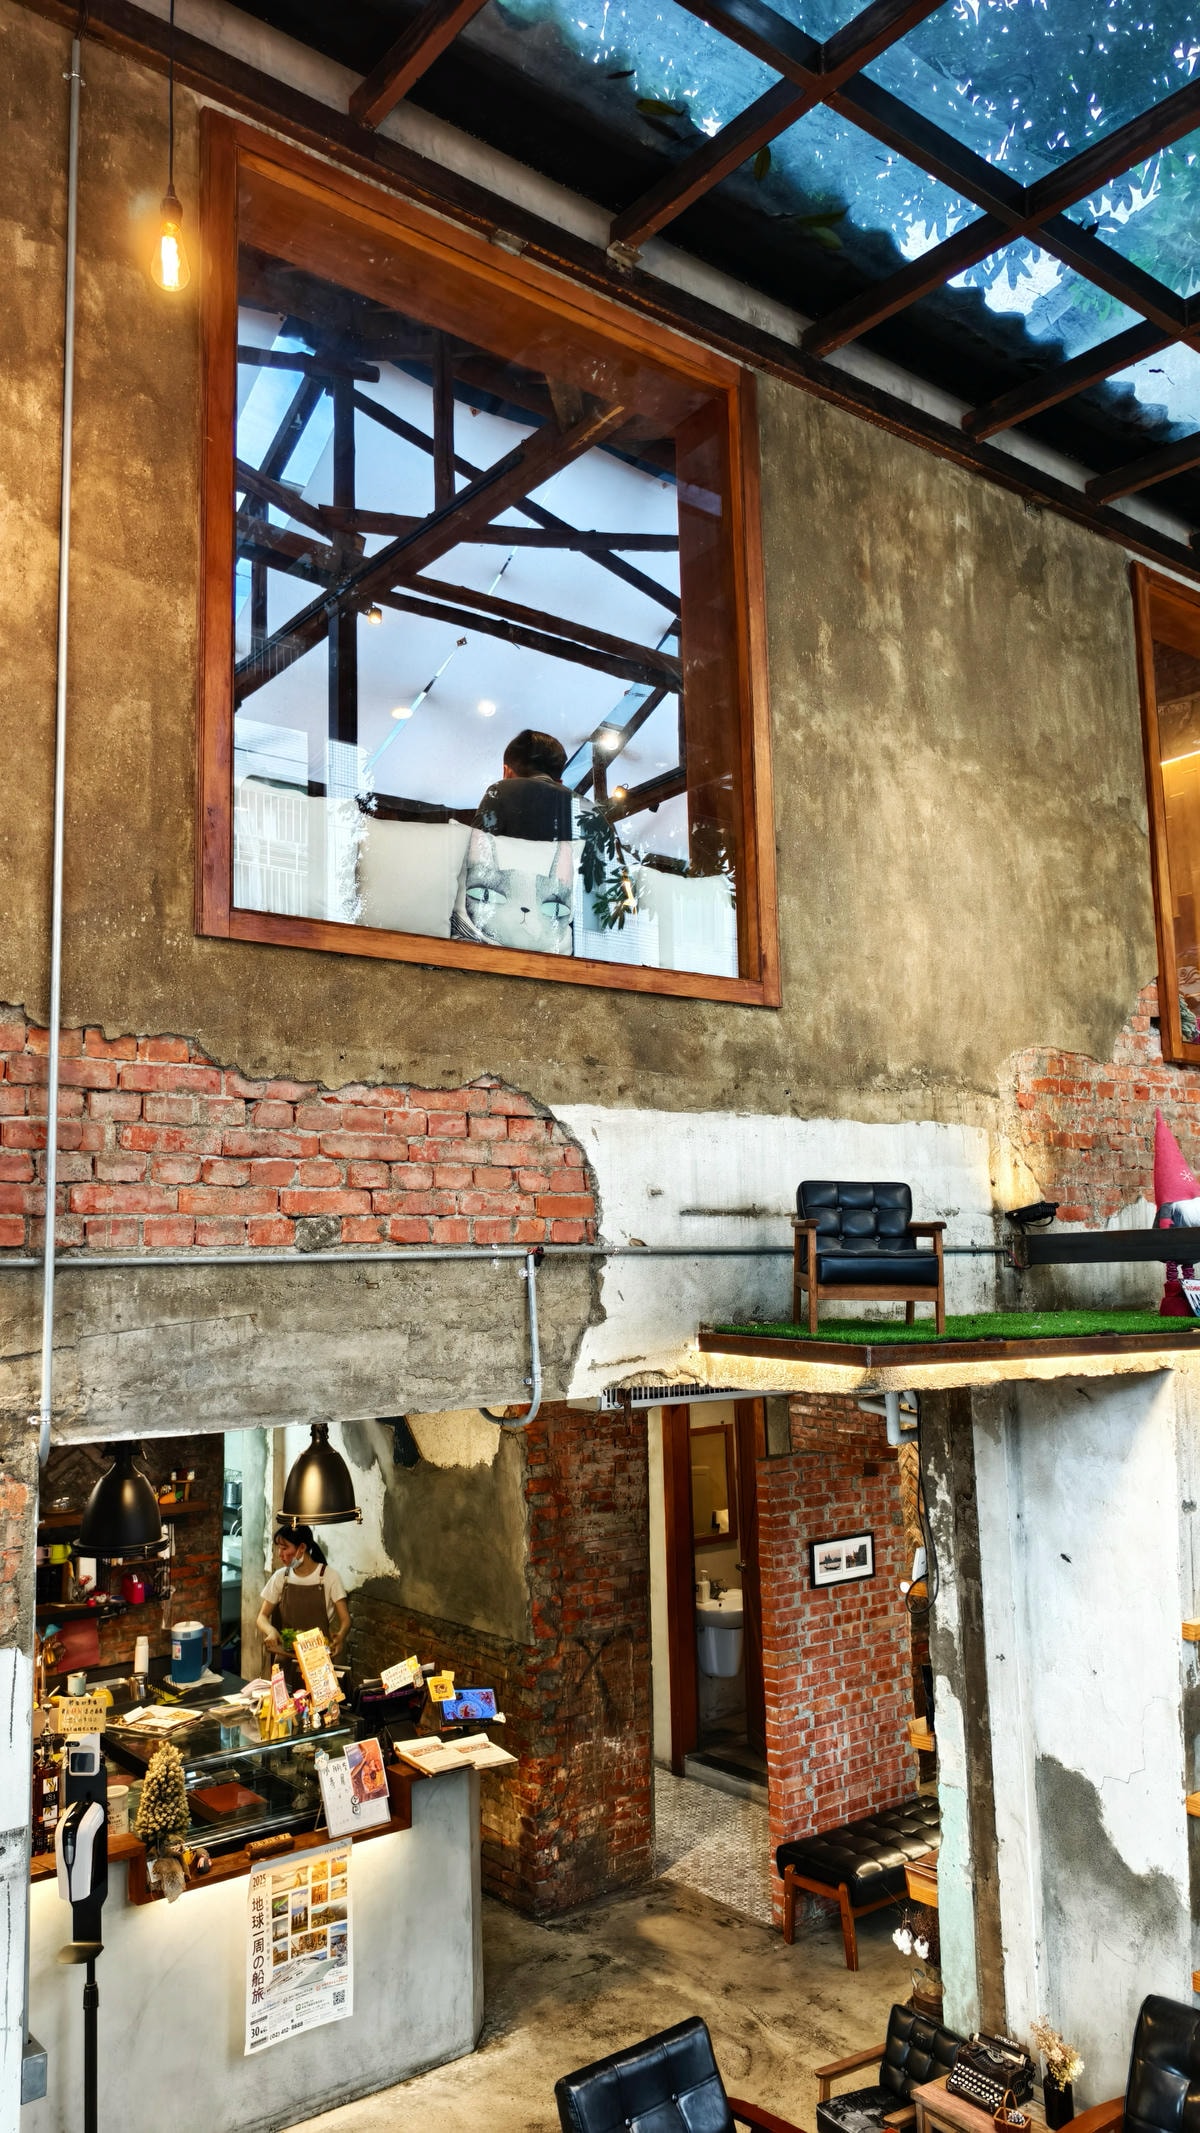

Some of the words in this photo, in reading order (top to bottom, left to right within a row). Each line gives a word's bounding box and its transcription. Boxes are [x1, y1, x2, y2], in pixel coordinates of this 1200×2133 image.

[252, 1896, 265, 2005] 地球一周の船旅
